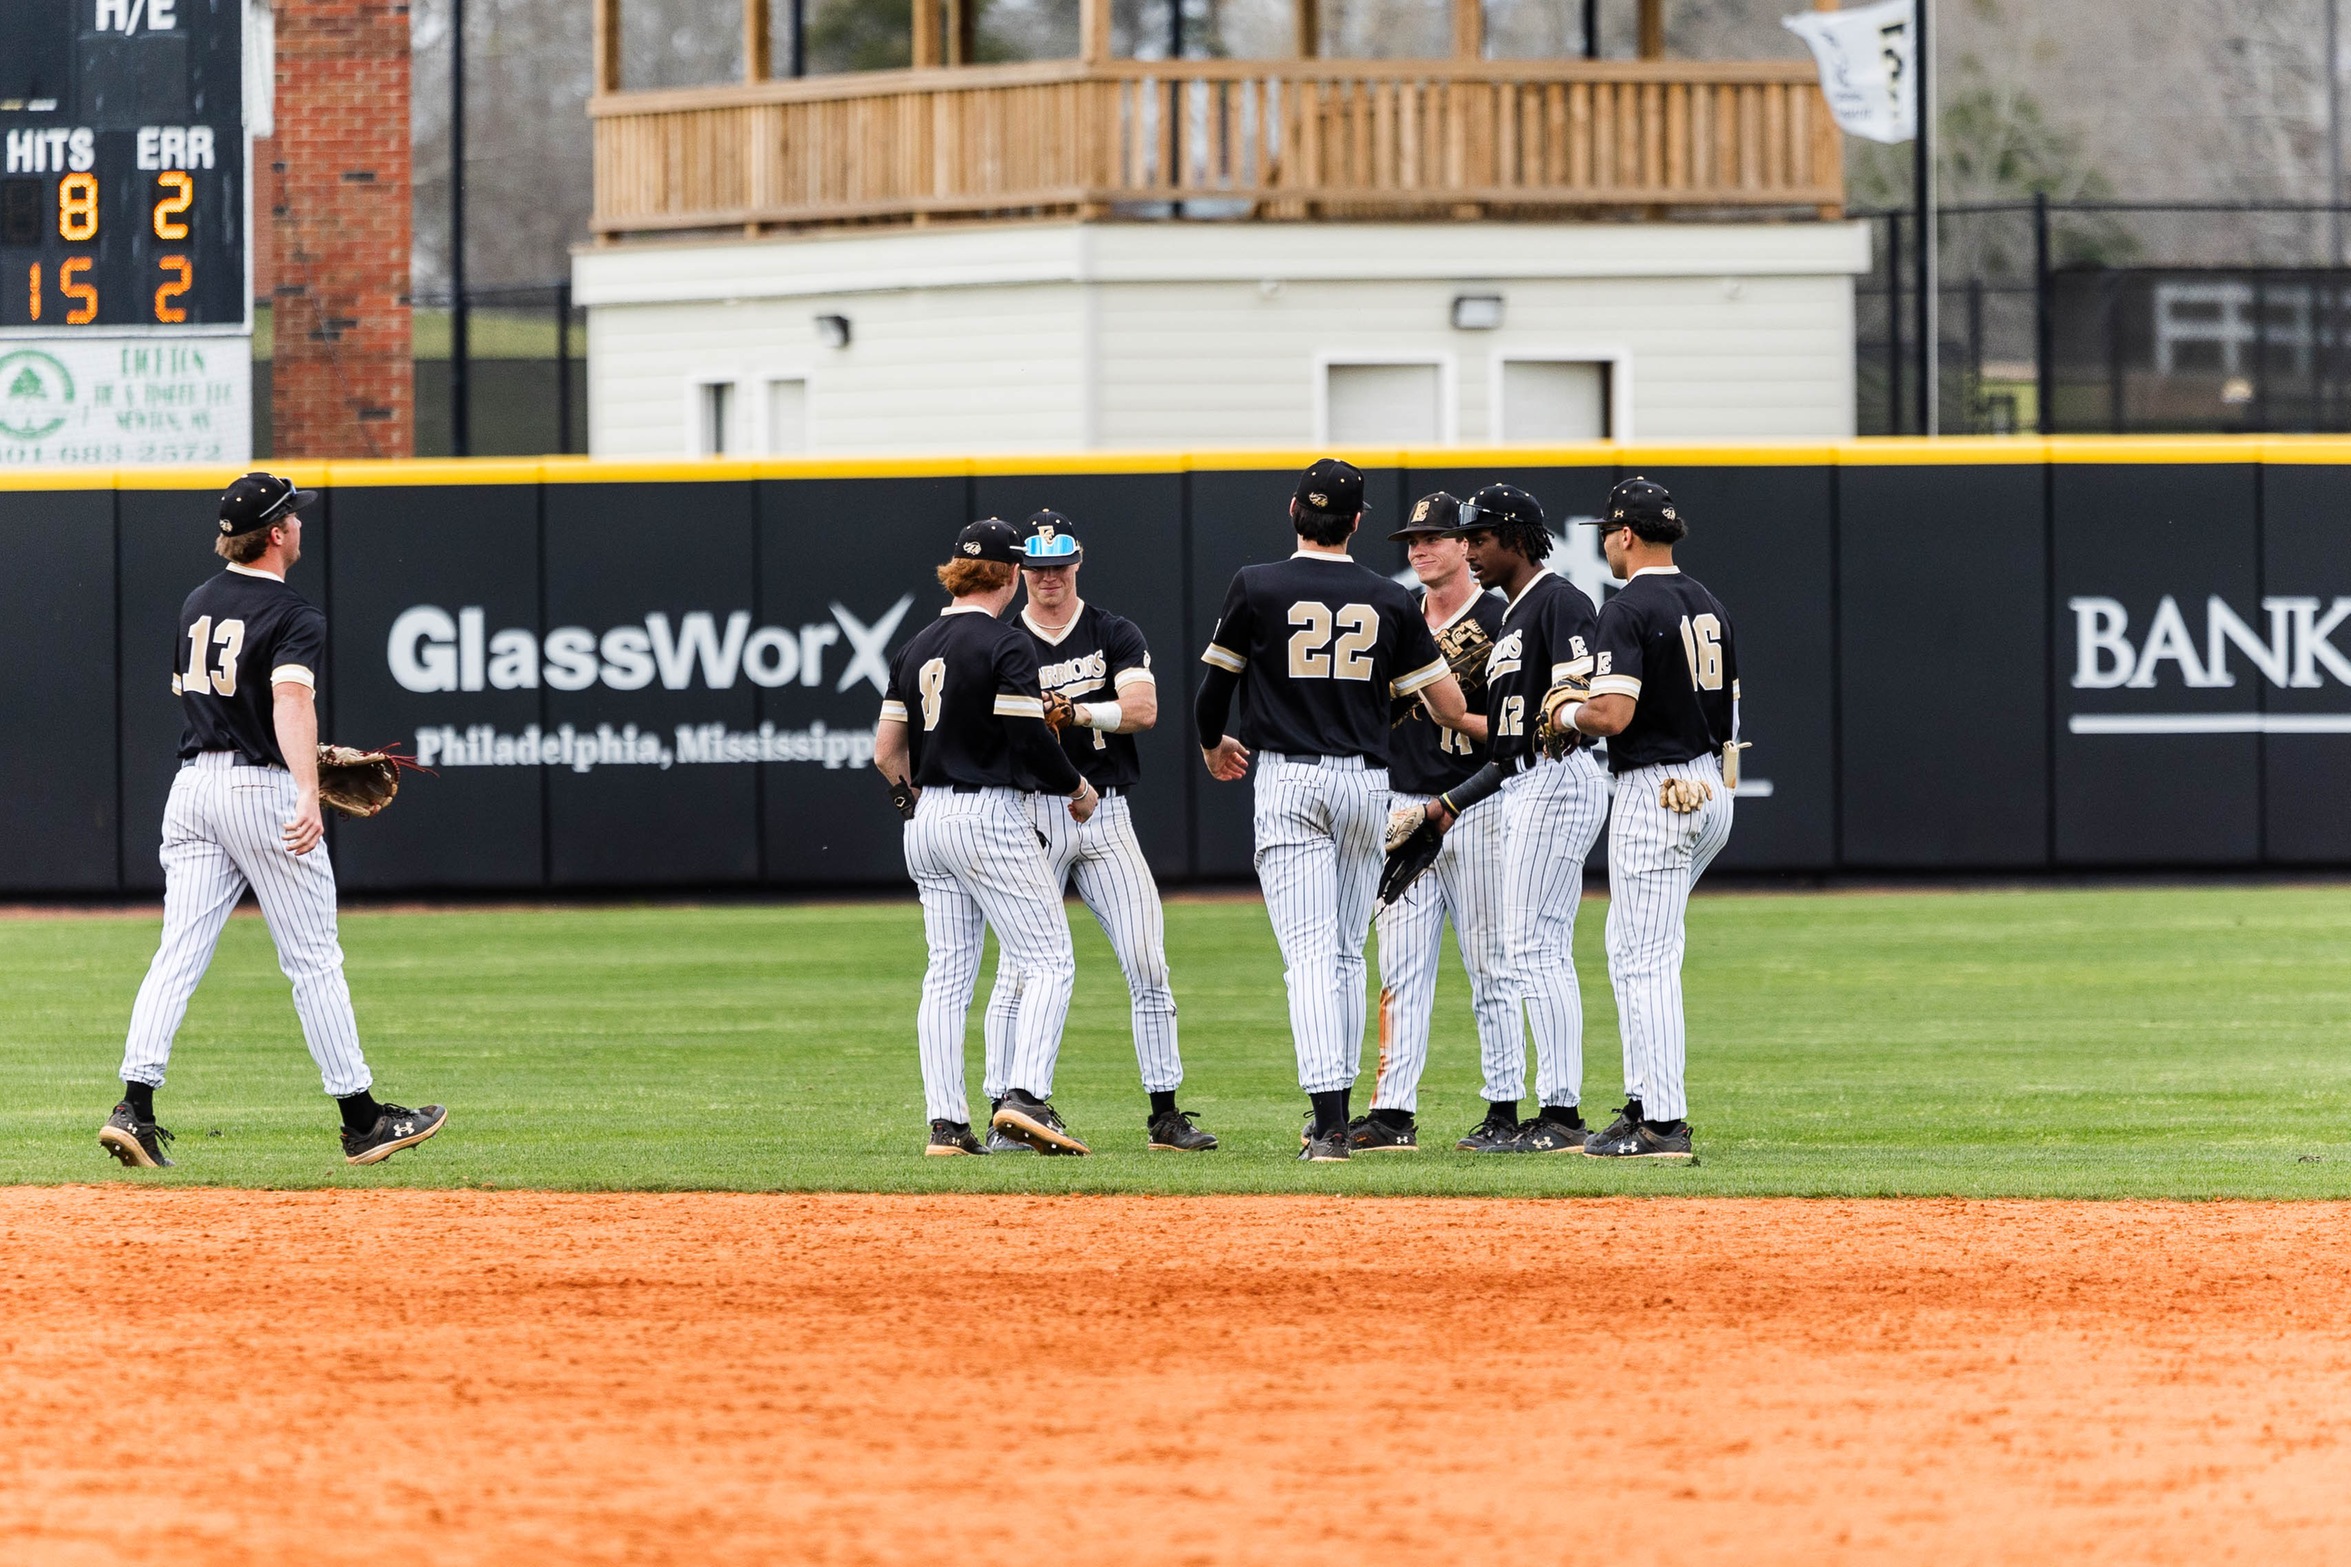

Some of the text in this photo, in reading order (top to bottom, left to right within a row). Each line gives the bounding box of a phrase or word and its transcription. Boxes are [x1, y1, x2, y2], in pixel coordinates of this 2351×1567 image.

[95, 0, 177, 36] H/E
[6, 125, 215, 173] HITS ERR
[59, 171, 193, 241] 8 2
[29, 255, 193, 325] 15 2
[183, 615, 245, 697] 13
[387, 594, 915, 696] GlassWorX
[1039, 649, 1106, 689] RRIORS
[1287, 600, 1380, 681] 22
[1680, 613, 1723, 692] 16
[2067, 594, 2351, 689] BANK
[416, 719, 878, 773] Philadelphia, Mississipp
[1497, 695, 1525, 736] 12
